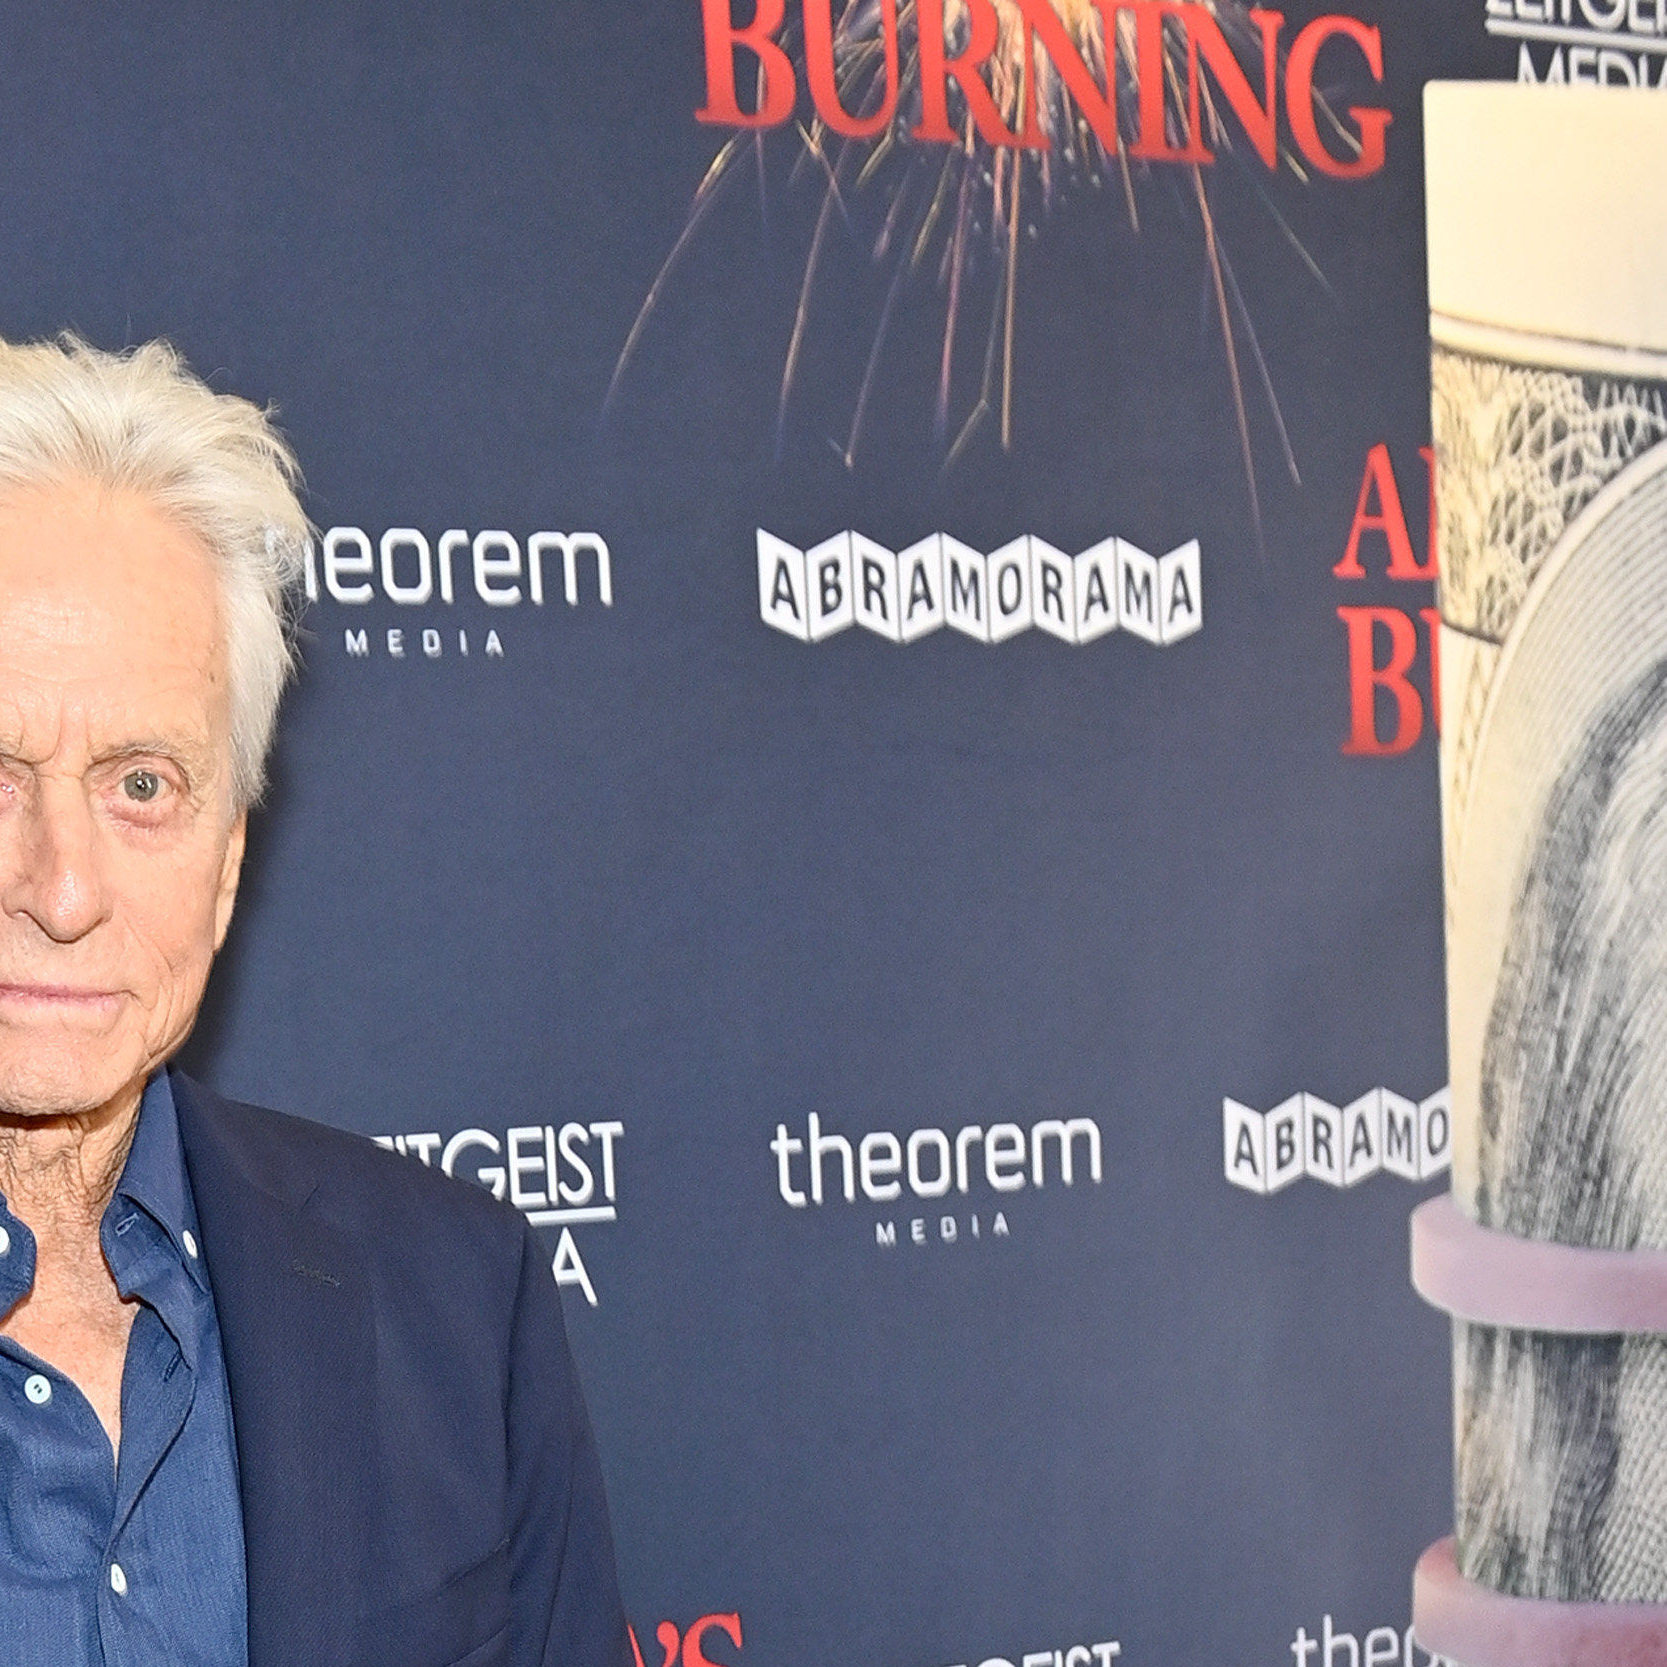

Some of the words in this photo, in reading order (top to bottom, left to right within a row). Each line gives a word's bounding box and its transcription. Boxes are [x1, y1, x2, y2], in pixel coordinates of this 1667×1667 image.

[694, 0, 1393, 179] BURNING
[766, 549, 1196, 629] ABRAMORAMA
[344, 627, 505, 658] MEDIA
[770, 1111, 1103, 1208] theorem
[1229, 1102, 1451, 1180] ABRAMO
[876, 1212, 1010, 1246] MEDIA
